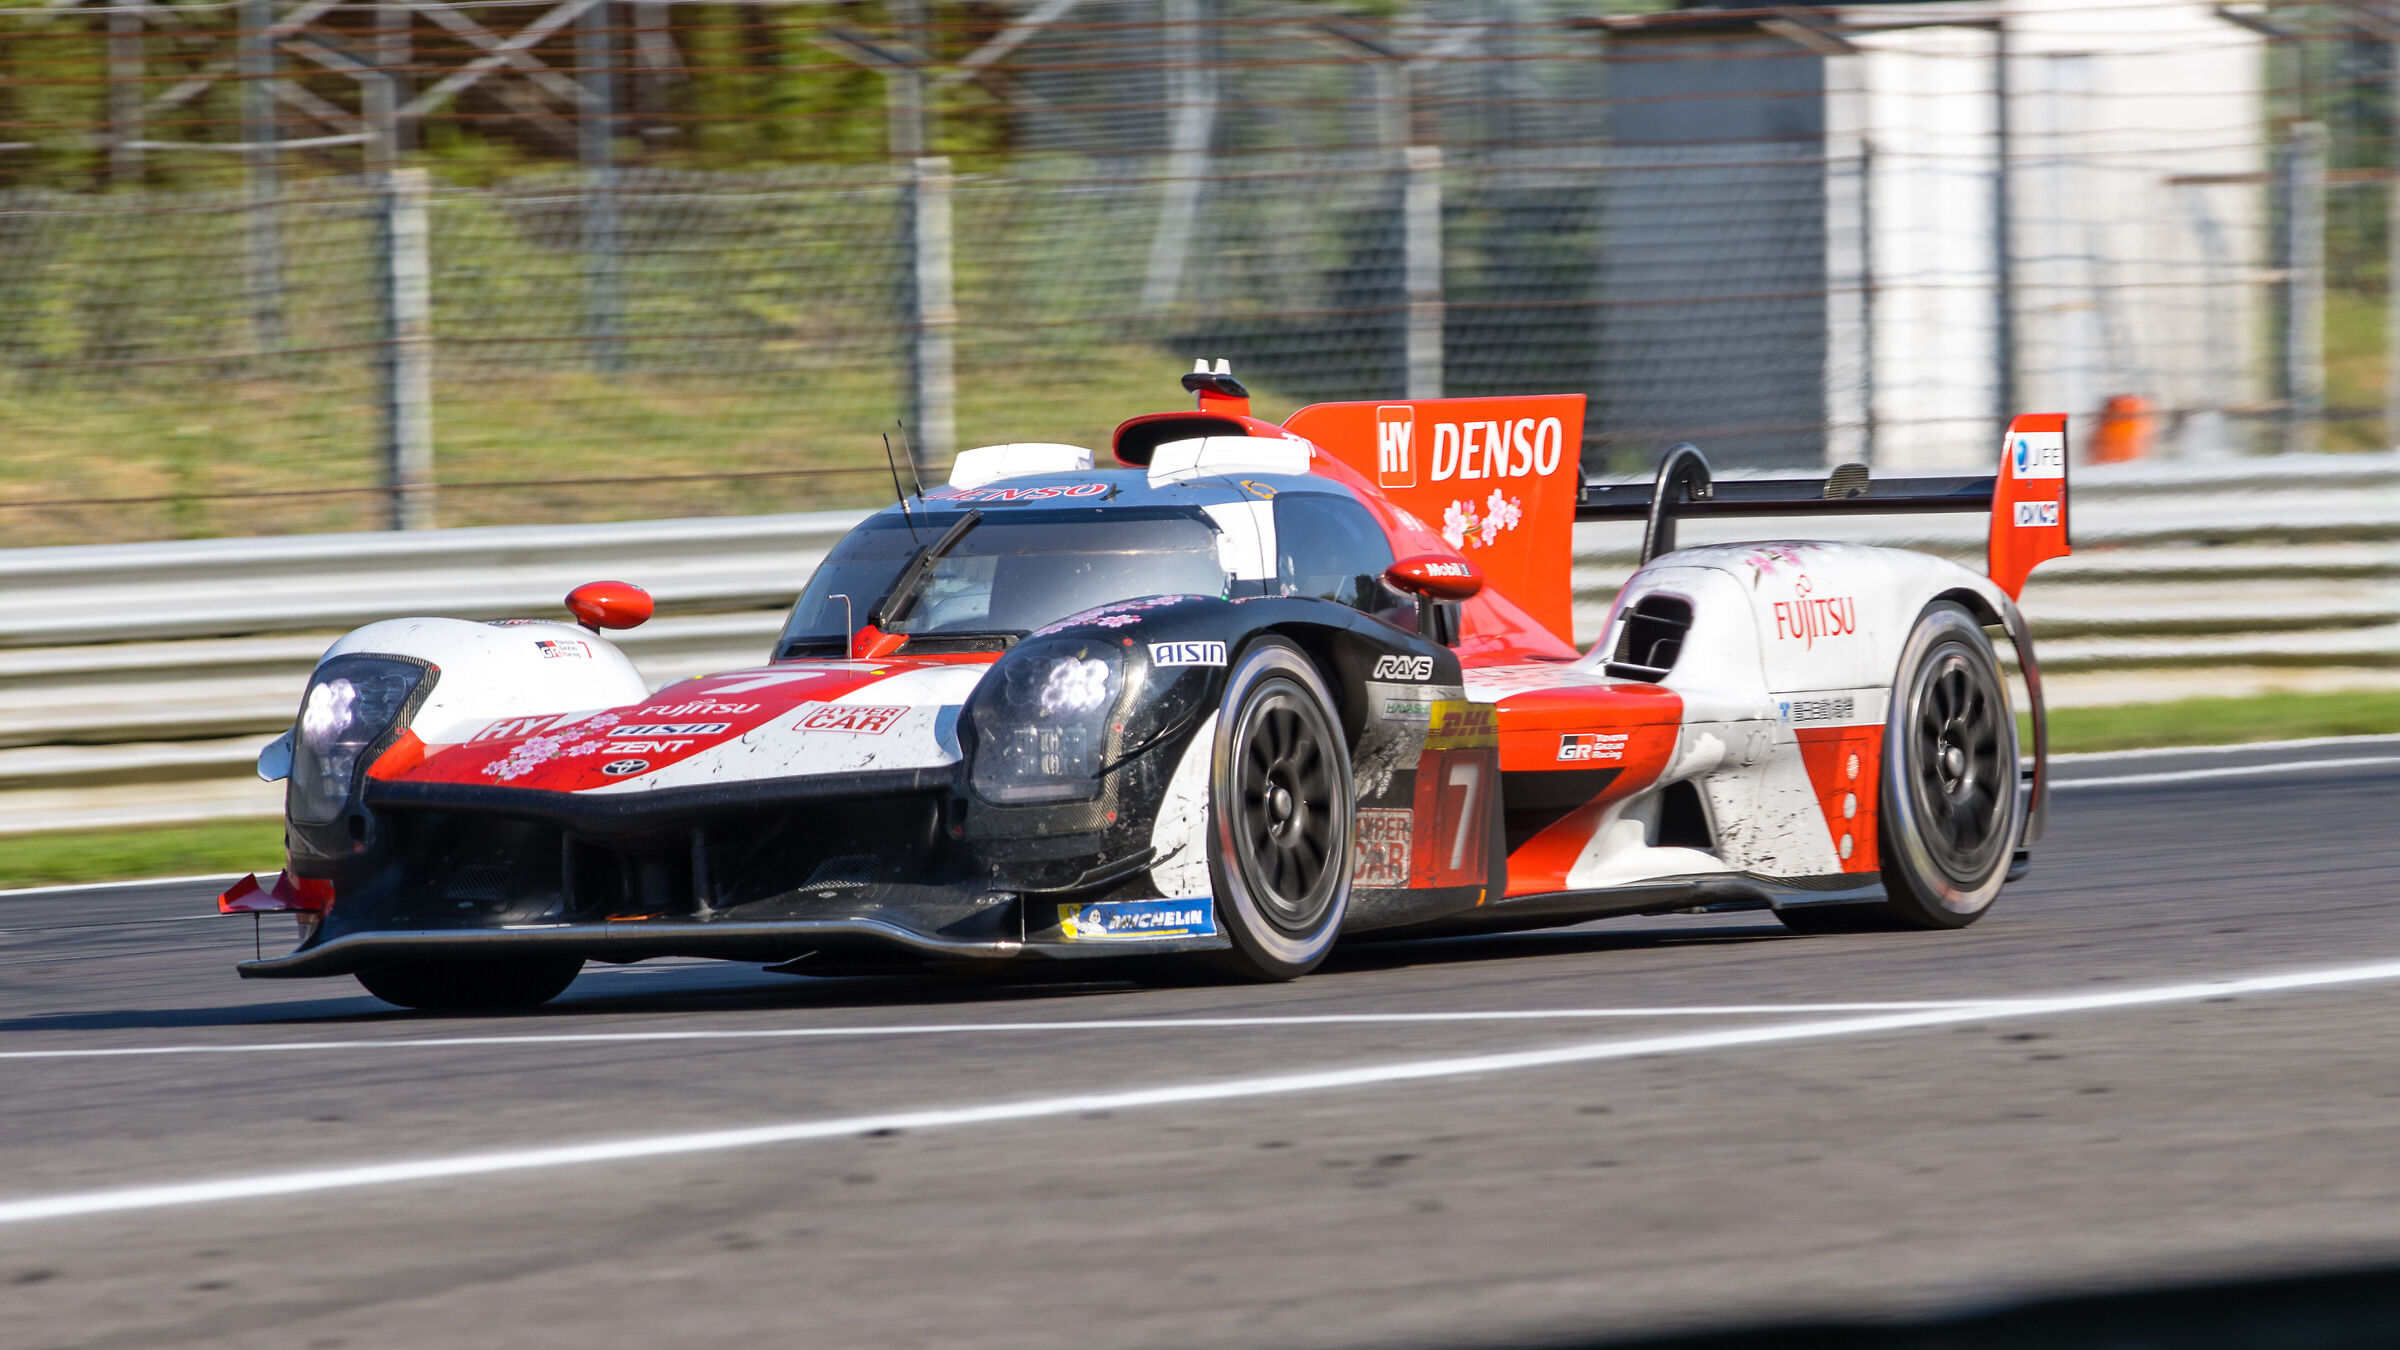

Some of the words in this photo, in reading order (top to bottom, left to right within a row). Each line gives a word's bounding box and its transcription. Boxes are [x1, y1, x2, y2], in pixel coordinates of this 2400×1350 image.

[1379, 421, 1413, 473] HY
[1431, 416, 1562, 481] DENSO
[1425, 562, 1462, 577] Mobil
[1773, 597, 1856, 651] FUJITSU
[1156, 644, 1223, 663] AISIN
[1373, 655, 1433, 680] RAYS
[637, 702, 761, 717] FUJITSU
[818, 706, 900, 716] HYPER
[474, 716, 558, 741] HY
[611, 724, 727, 736] AISIN
[804, 714, 889, 731] CAR
[1440, 711, 1492, 737] DHL
[601, 740, 695, 754] ZENT
[1560, 744, 1592, 759] GR
[1448, 764, 1479, 871] 7
[1109, 910, 1203, 930] MICHELIN
